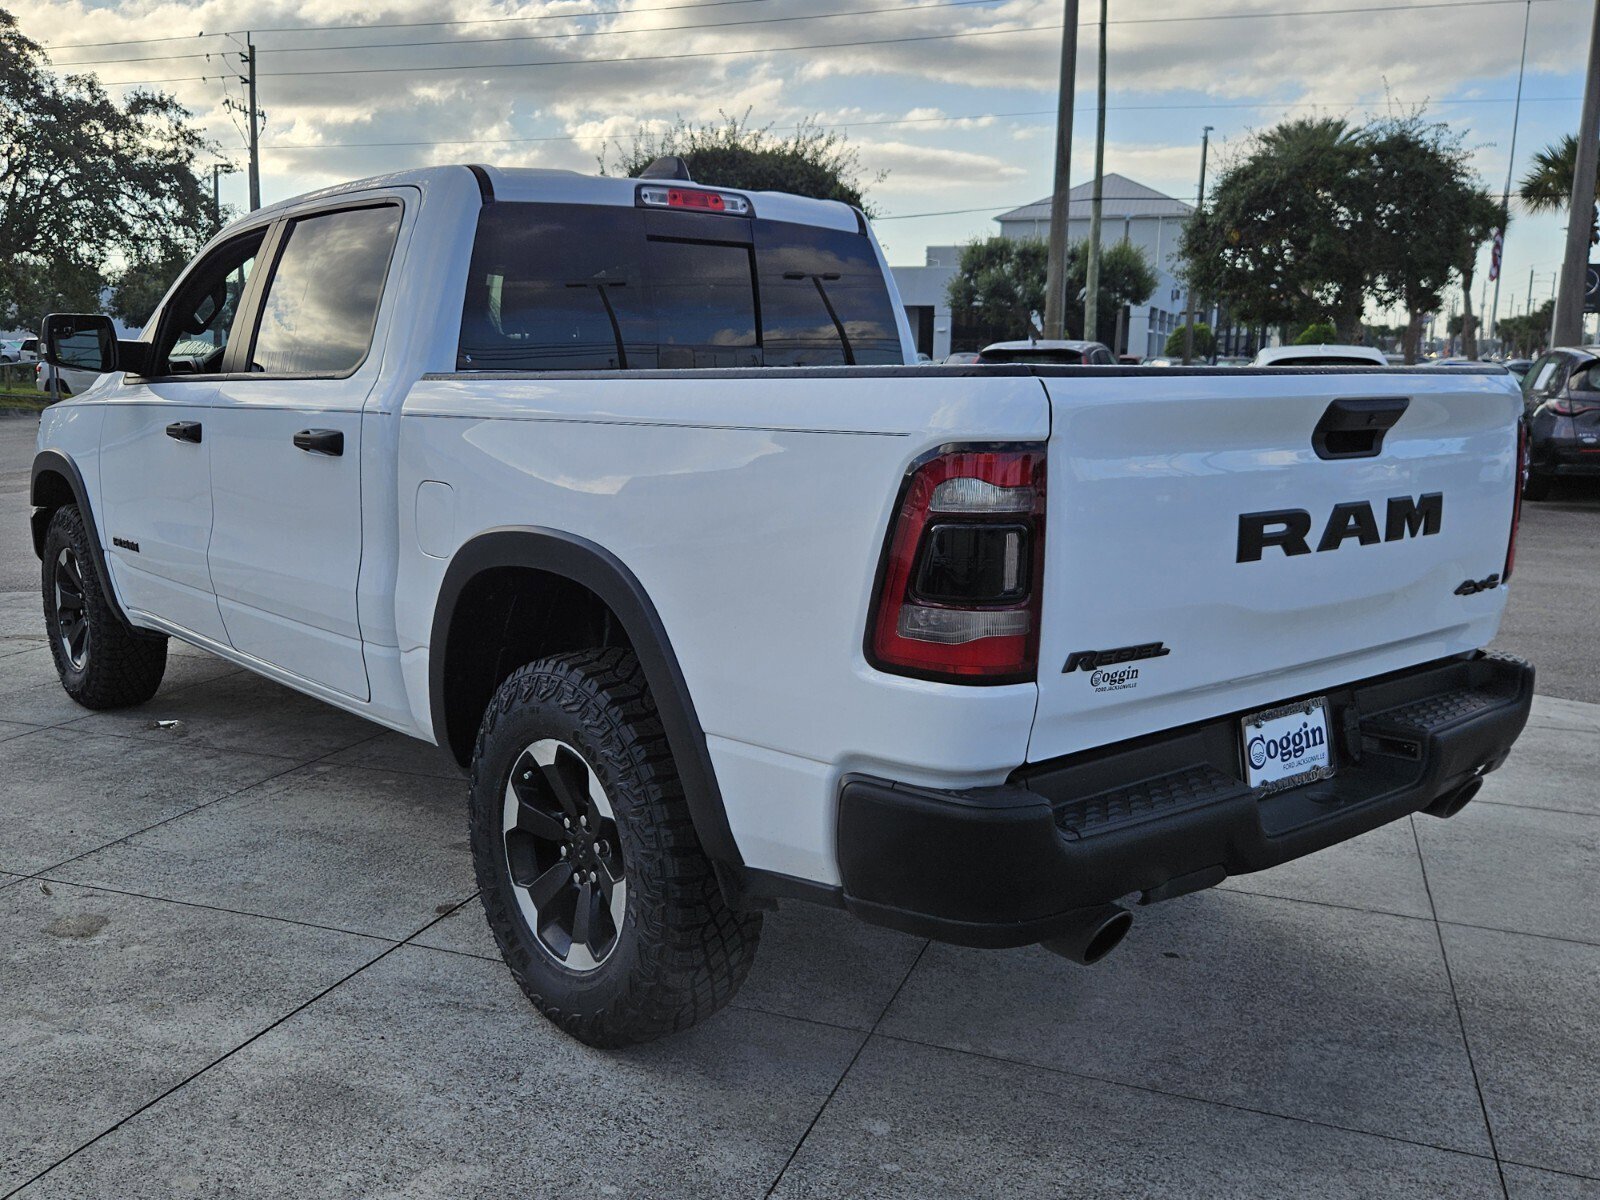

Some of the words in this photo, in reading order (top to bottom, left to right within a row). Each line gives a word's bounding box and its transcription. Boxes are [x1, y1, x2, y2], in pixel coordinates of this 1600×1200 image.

[1236, 491, 1443, 563] RAM
[1061, 641, 1171, 673] REBEL
[1090, 665, 1139, 687] Coggin
[1247, 721, 1325, 770] Coggin
[1283, 762, 1295, 770] FORD
[1296, 752, 1325, 768] JACKSONVILLE
